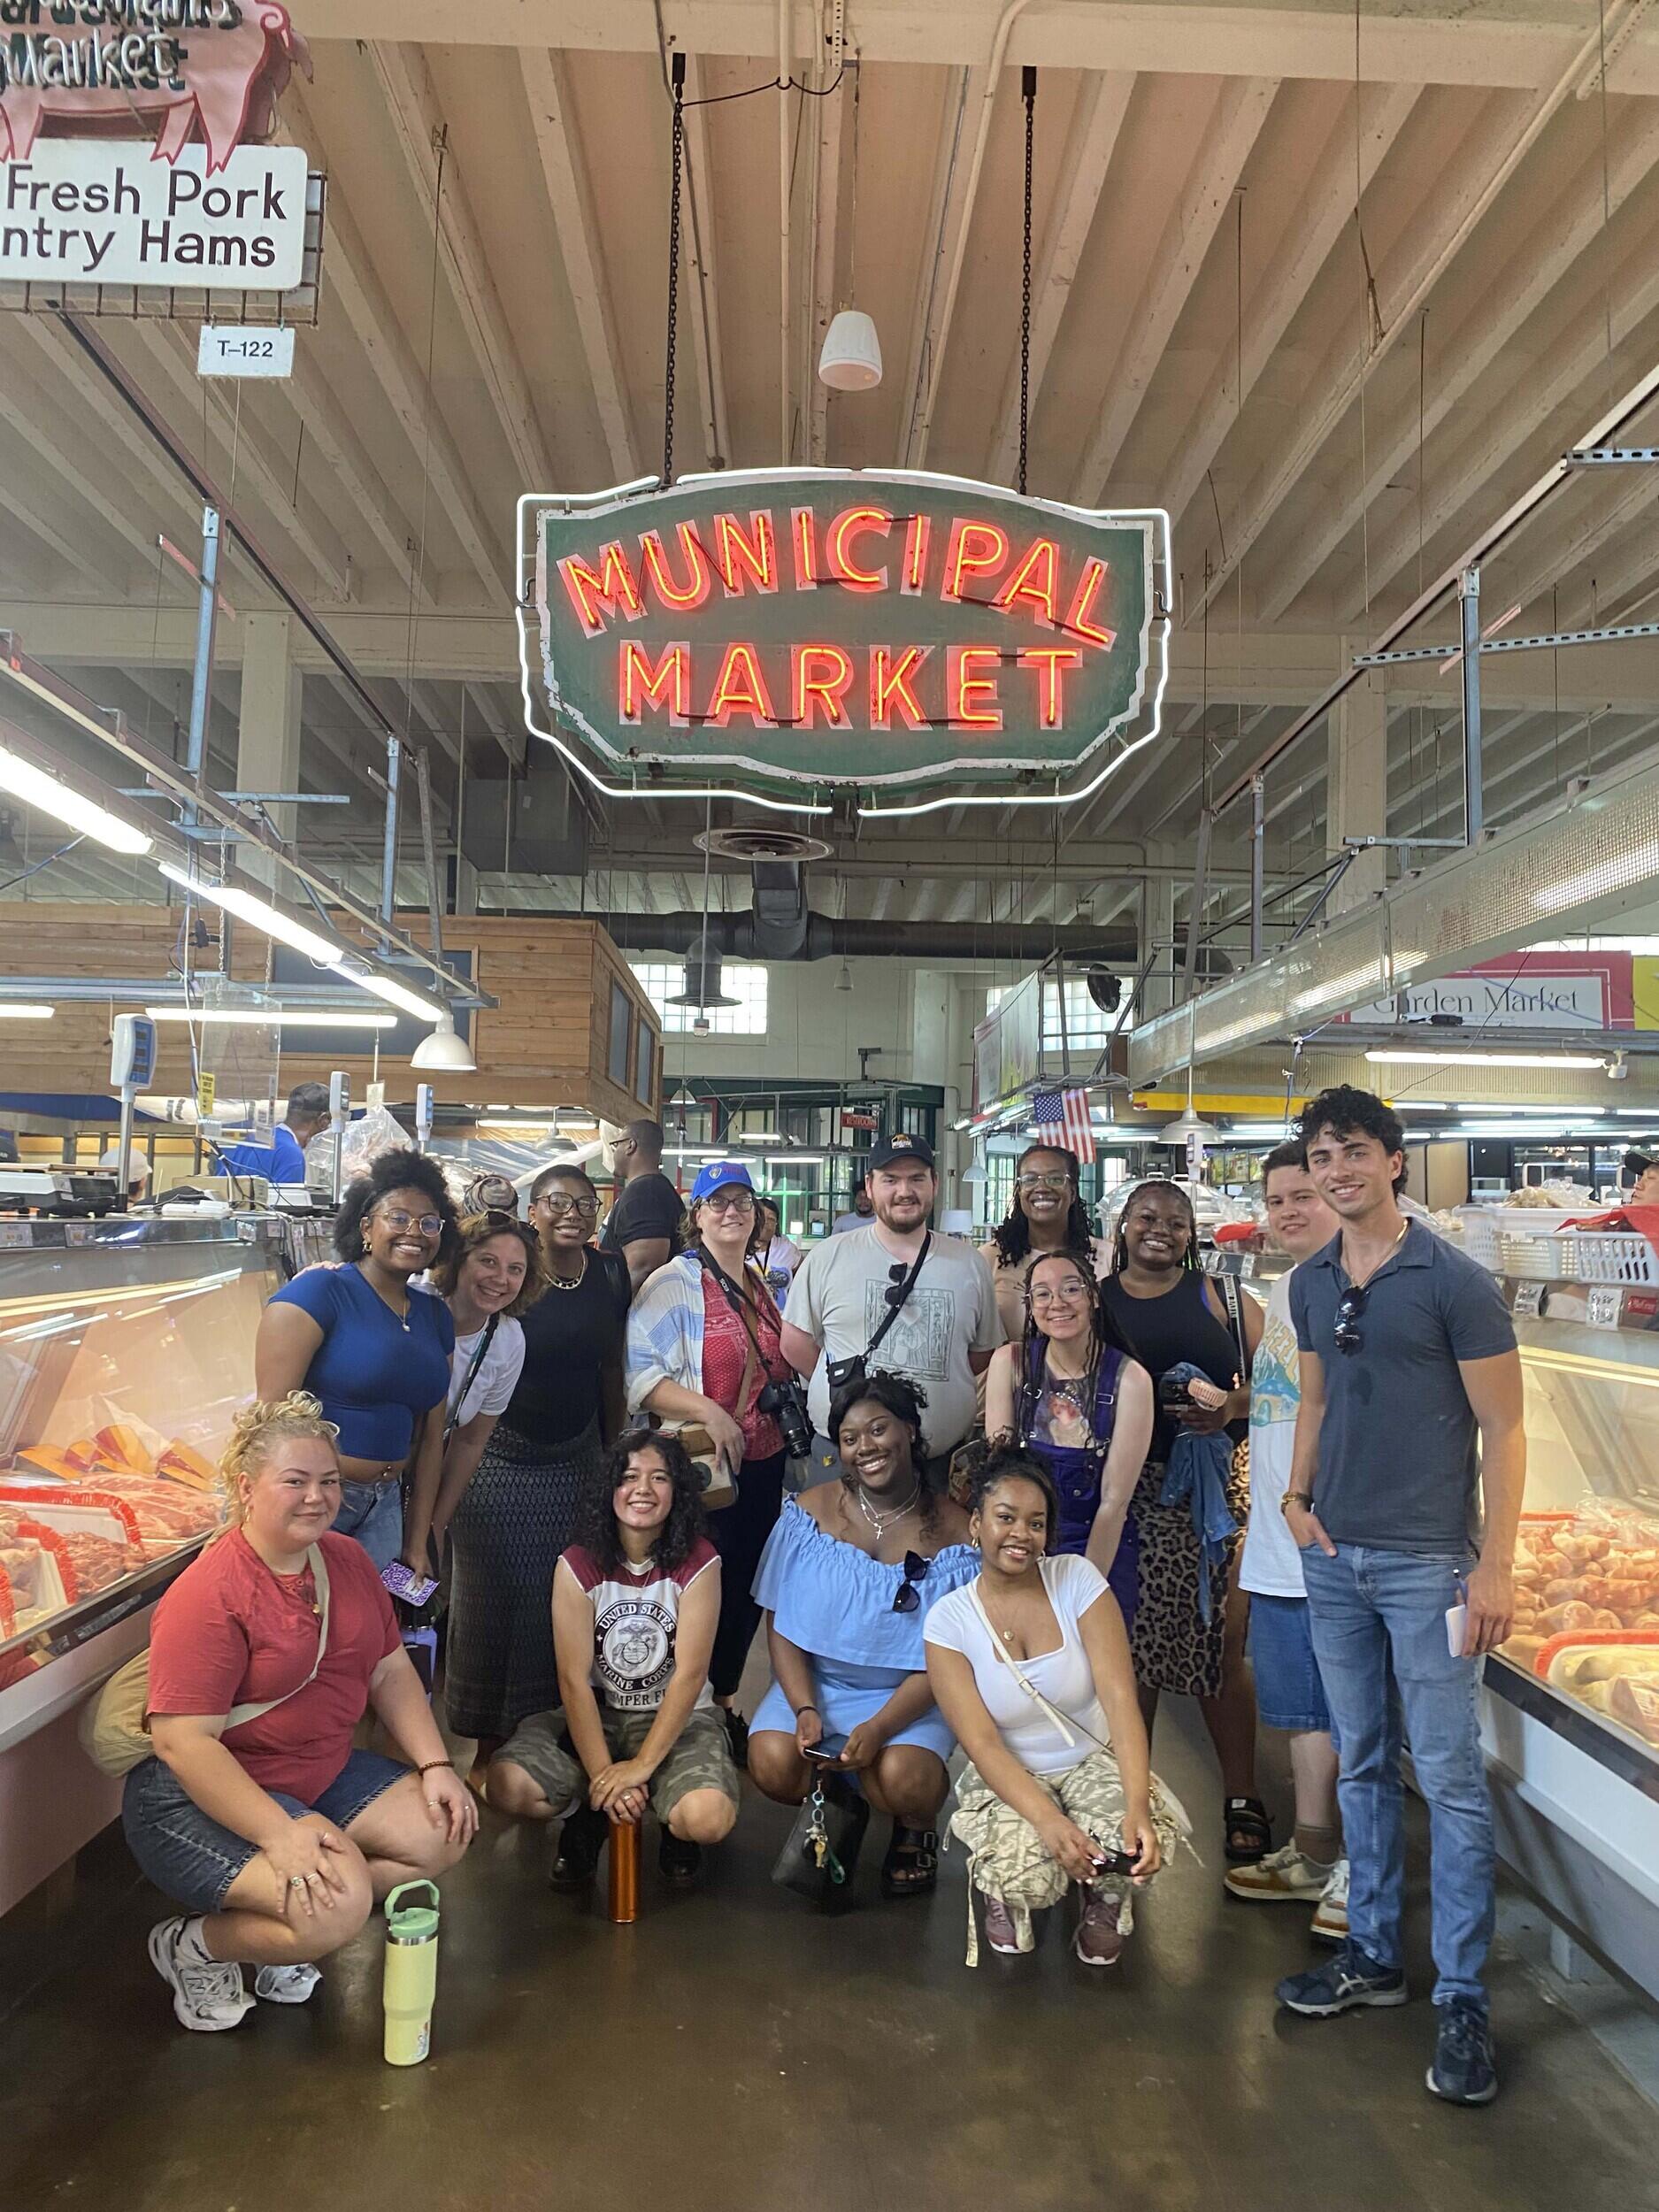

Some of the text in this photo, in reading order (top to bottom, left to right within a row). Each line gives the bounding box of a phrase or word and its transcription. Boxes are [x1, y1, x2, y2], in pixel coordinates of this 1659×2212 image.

[6, 164, 287, 220] Fresh Pork
[2, 218, 276, 273] ntry Hams
[217, 340, 273, 358] T-122
[556, 506, 1117, 651] MUNICIPAL
[619, 640, 1082, 732] MARKET
[1485, 987, 1578, 1014] Market
[599, 1602, 675, 1632] UNITED STATES
[596, 1654, 673, 1690] MARINE CORPS
